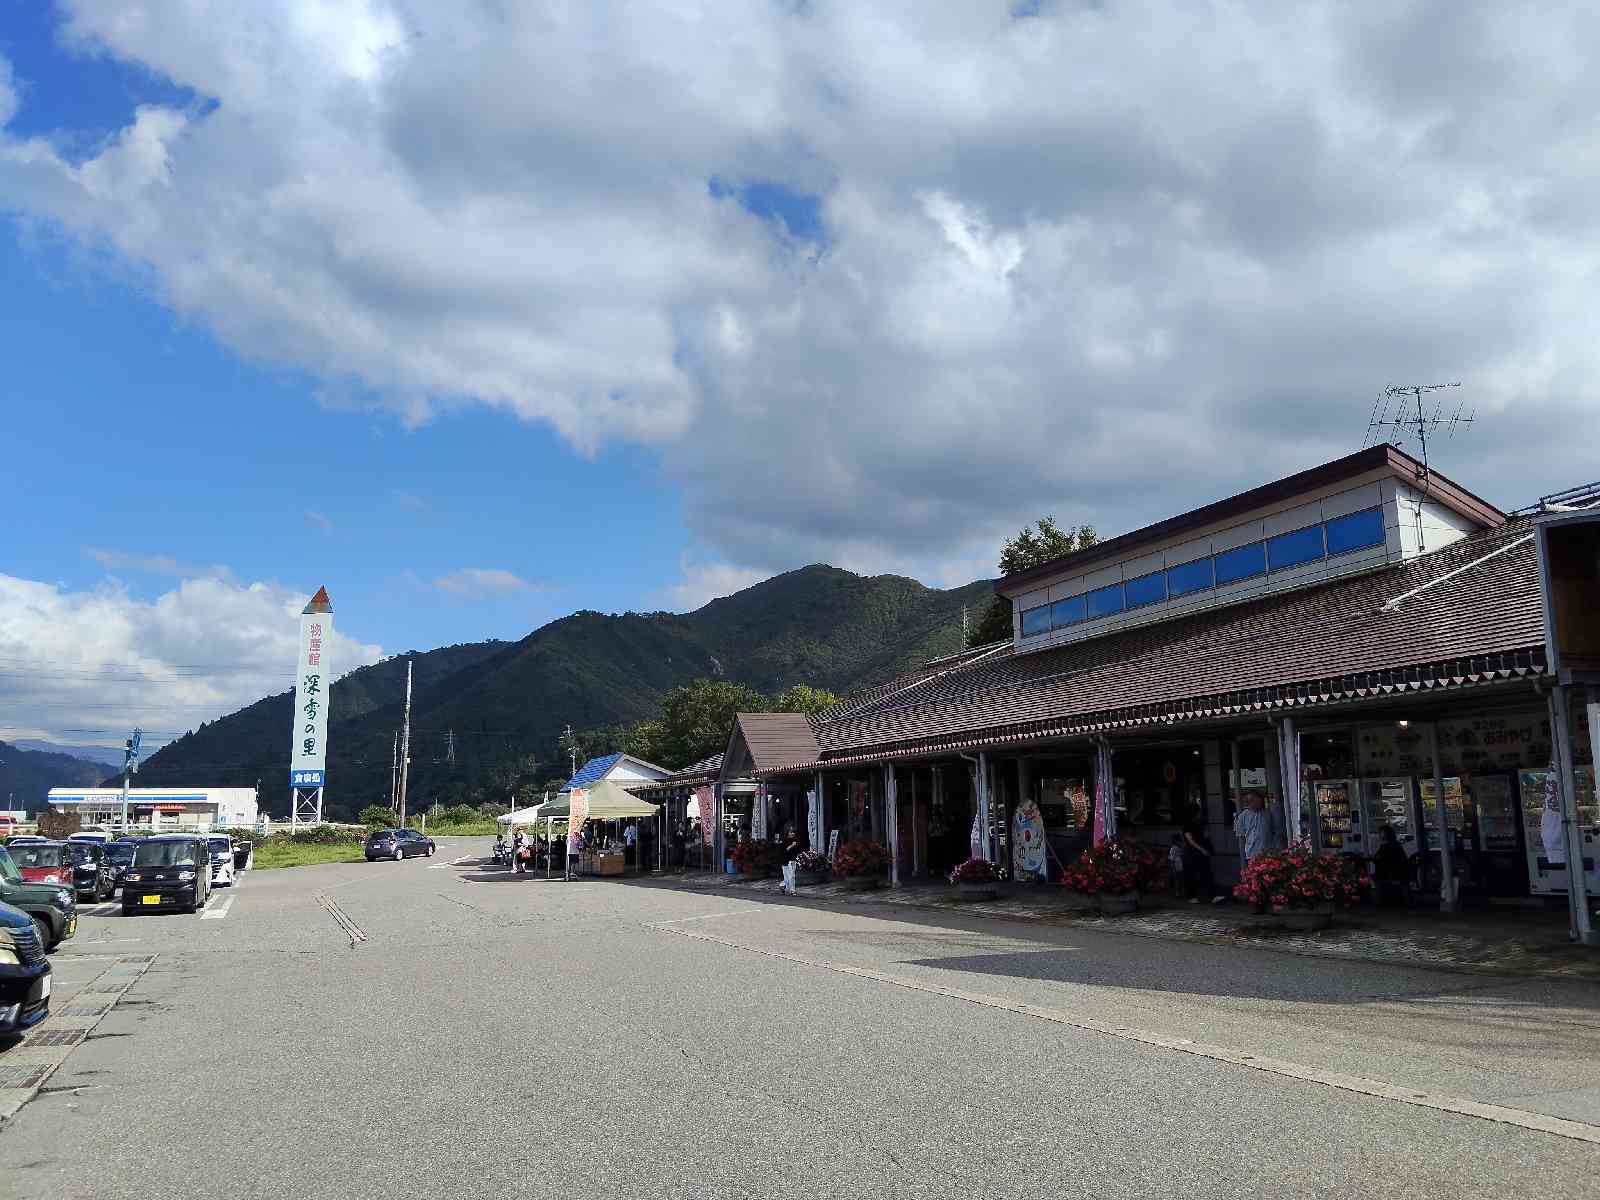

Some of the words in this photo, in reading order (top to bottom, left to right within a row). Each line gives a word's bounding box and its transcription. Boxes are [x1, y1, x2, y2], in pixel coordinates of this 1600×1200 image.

[308, 623, 322, 666] 物産館
[302, 674, 321, 757] 深雪の里
[294, 773, 321, 784] 食事処
